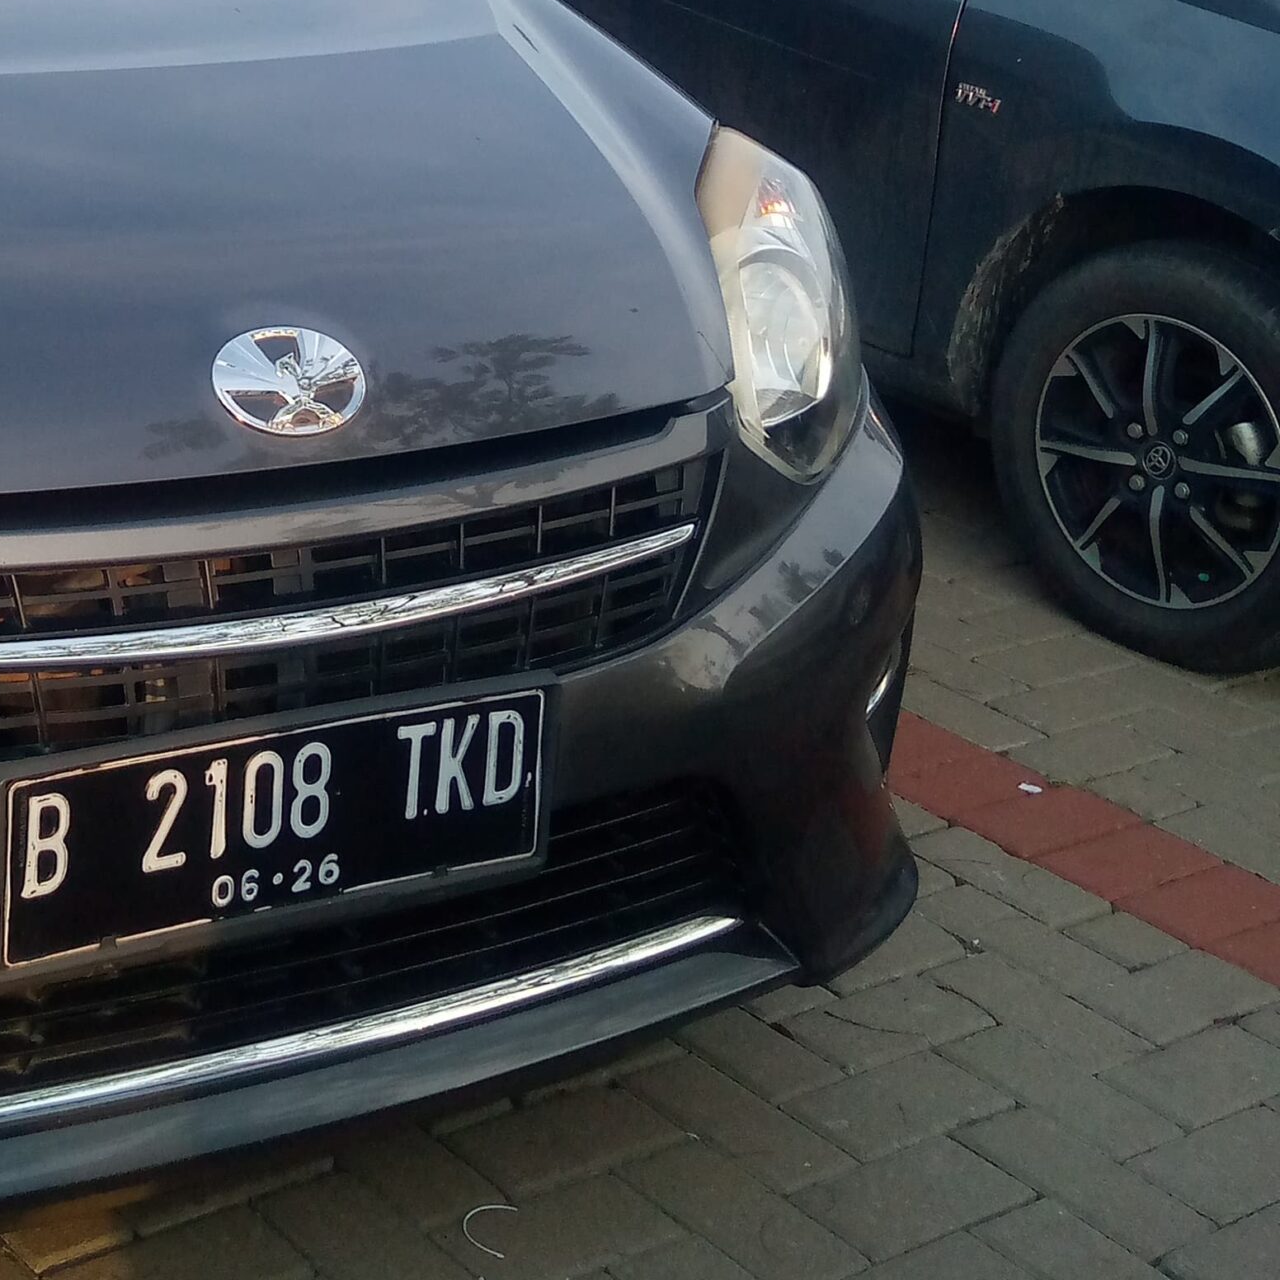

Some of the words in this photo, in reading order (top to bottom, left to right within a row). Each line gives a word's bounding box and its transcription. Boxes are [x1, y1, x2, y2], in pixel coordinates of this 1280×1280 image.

[21, 792, 71, 899] B
[141, 741, 333, 874] 2108
[397, 709, 525, 820] TKD
